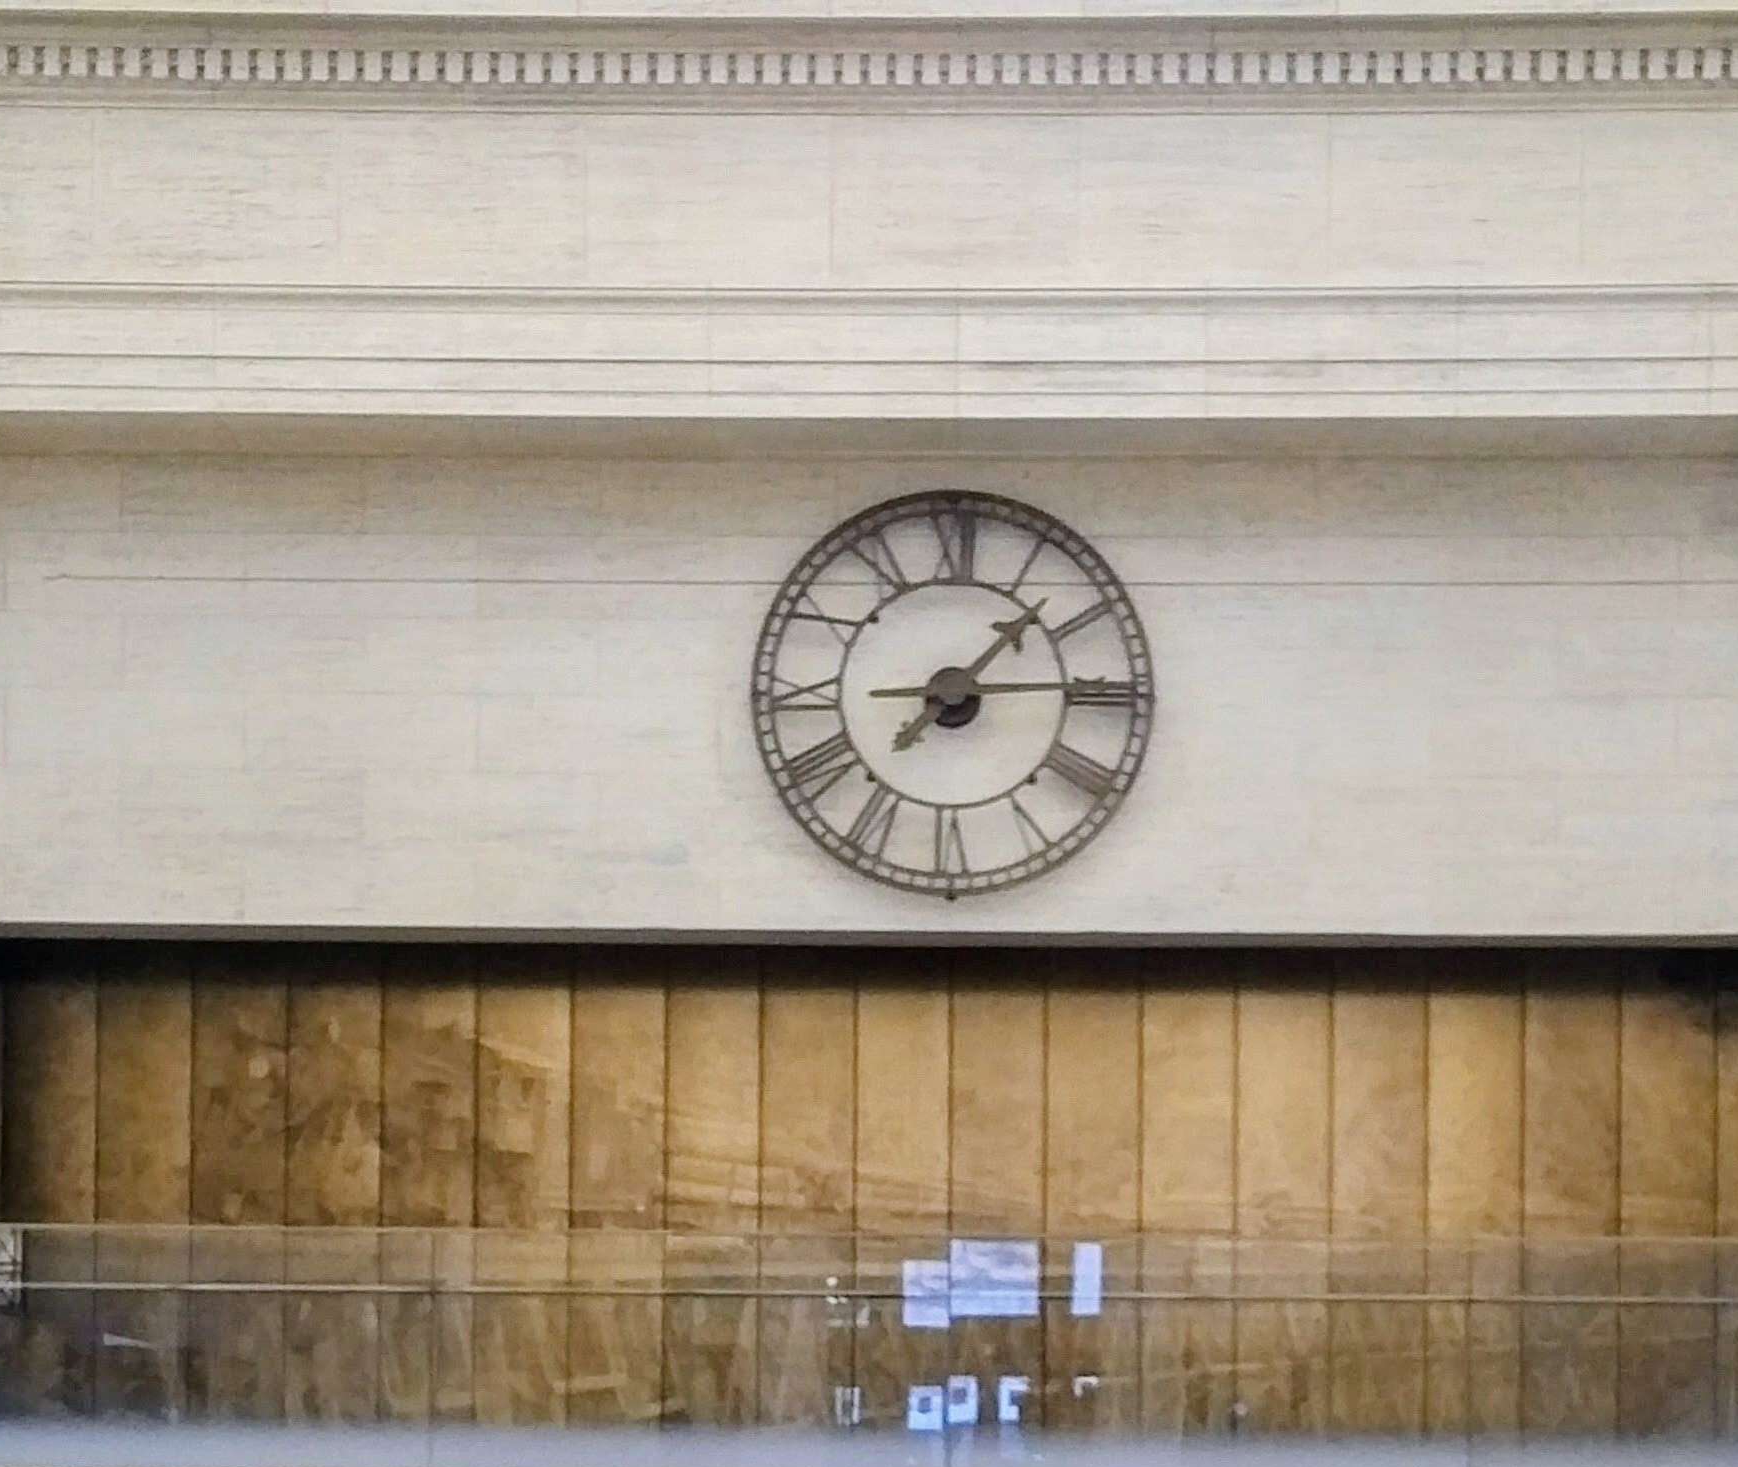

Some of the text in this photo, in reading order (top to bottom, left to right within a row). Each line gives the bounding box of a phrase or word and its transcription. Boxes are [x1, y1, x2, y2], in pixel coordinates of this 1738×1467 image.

[848, 531, 909, 599] XI
[932, 513, 977, 581] XII
[786, 593, 863, 646] X
[1049, 600, 1112, 642] II
[773, 676, 841, 712] IX
[784, 731, 863, 802] VIII
[846, 786, 901, 859] VII
[933, 806, 971, 875] VI
[1010, 793, 1054, 855] V
